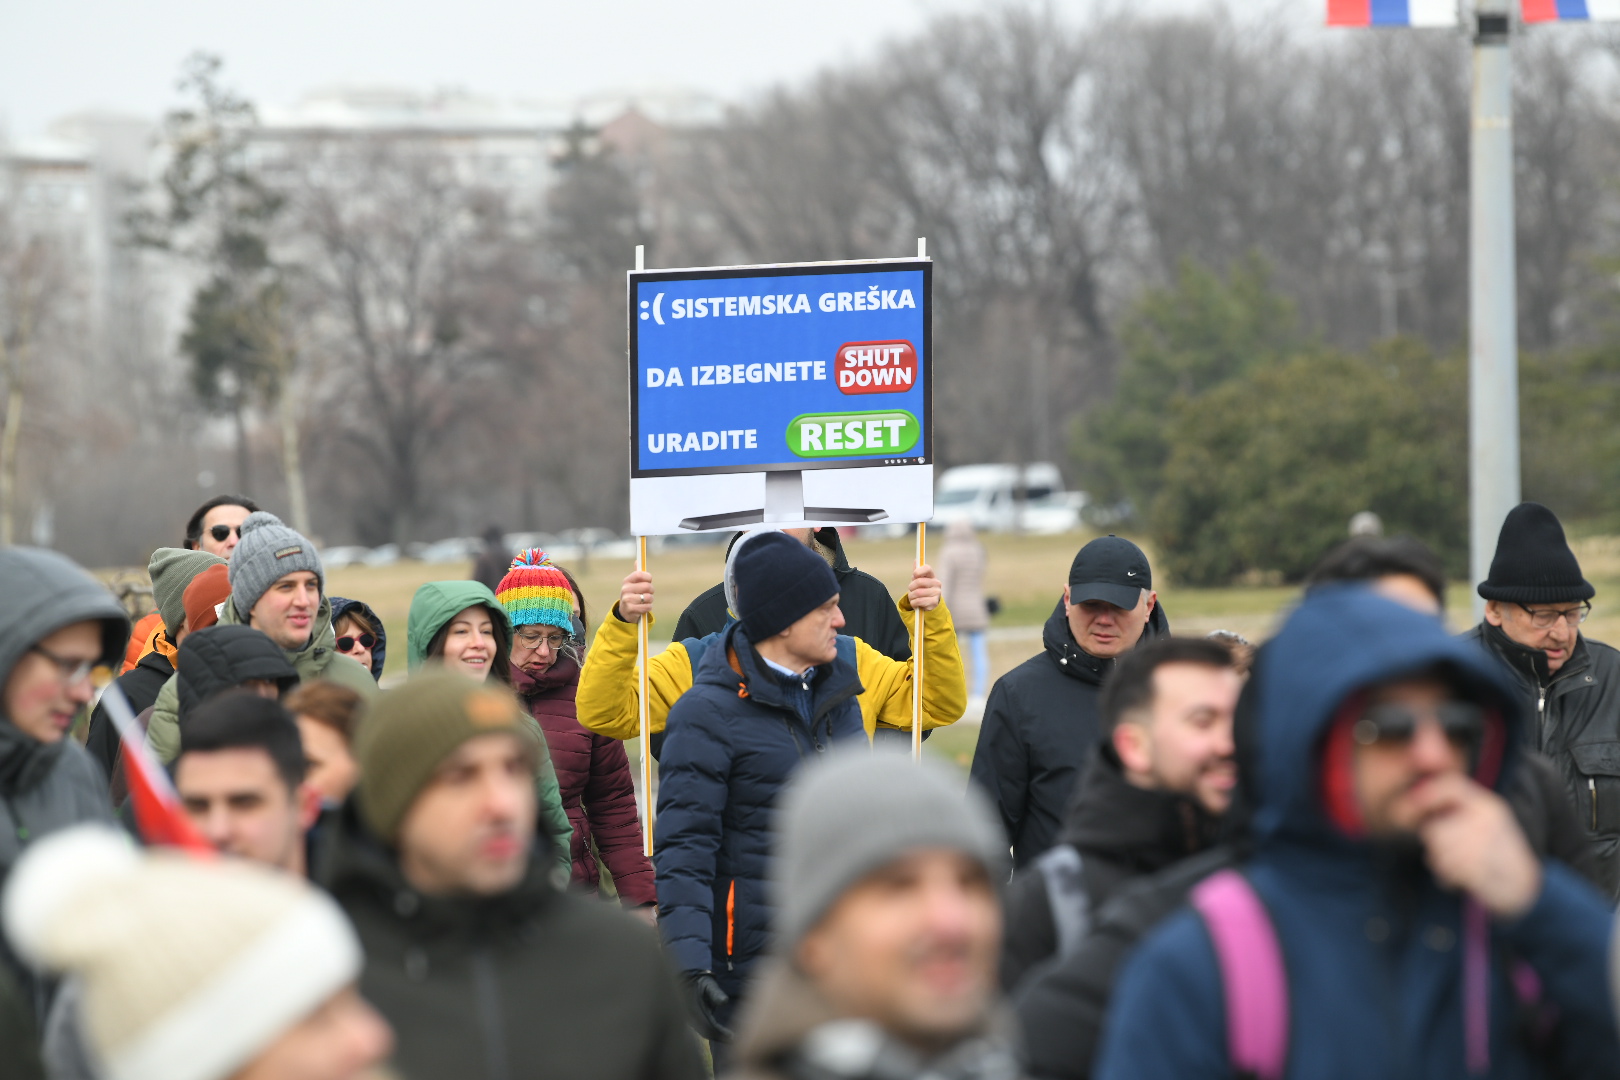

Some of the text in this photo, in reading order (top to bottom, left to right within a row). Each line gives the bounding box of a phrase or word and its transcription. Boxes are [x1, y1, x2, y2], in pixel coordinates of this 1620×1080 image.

[671, 294, 811, 319] SISTEMSKA
[818, 285, 916, 313] GREŠKA
[844, 348, 904, 368] SHUT
[646, 360, 826, 388] DA IZBEGNETE
[839, 367, 912, 388] DOWN
[647, 419, 906, 453] URADITE RESET
